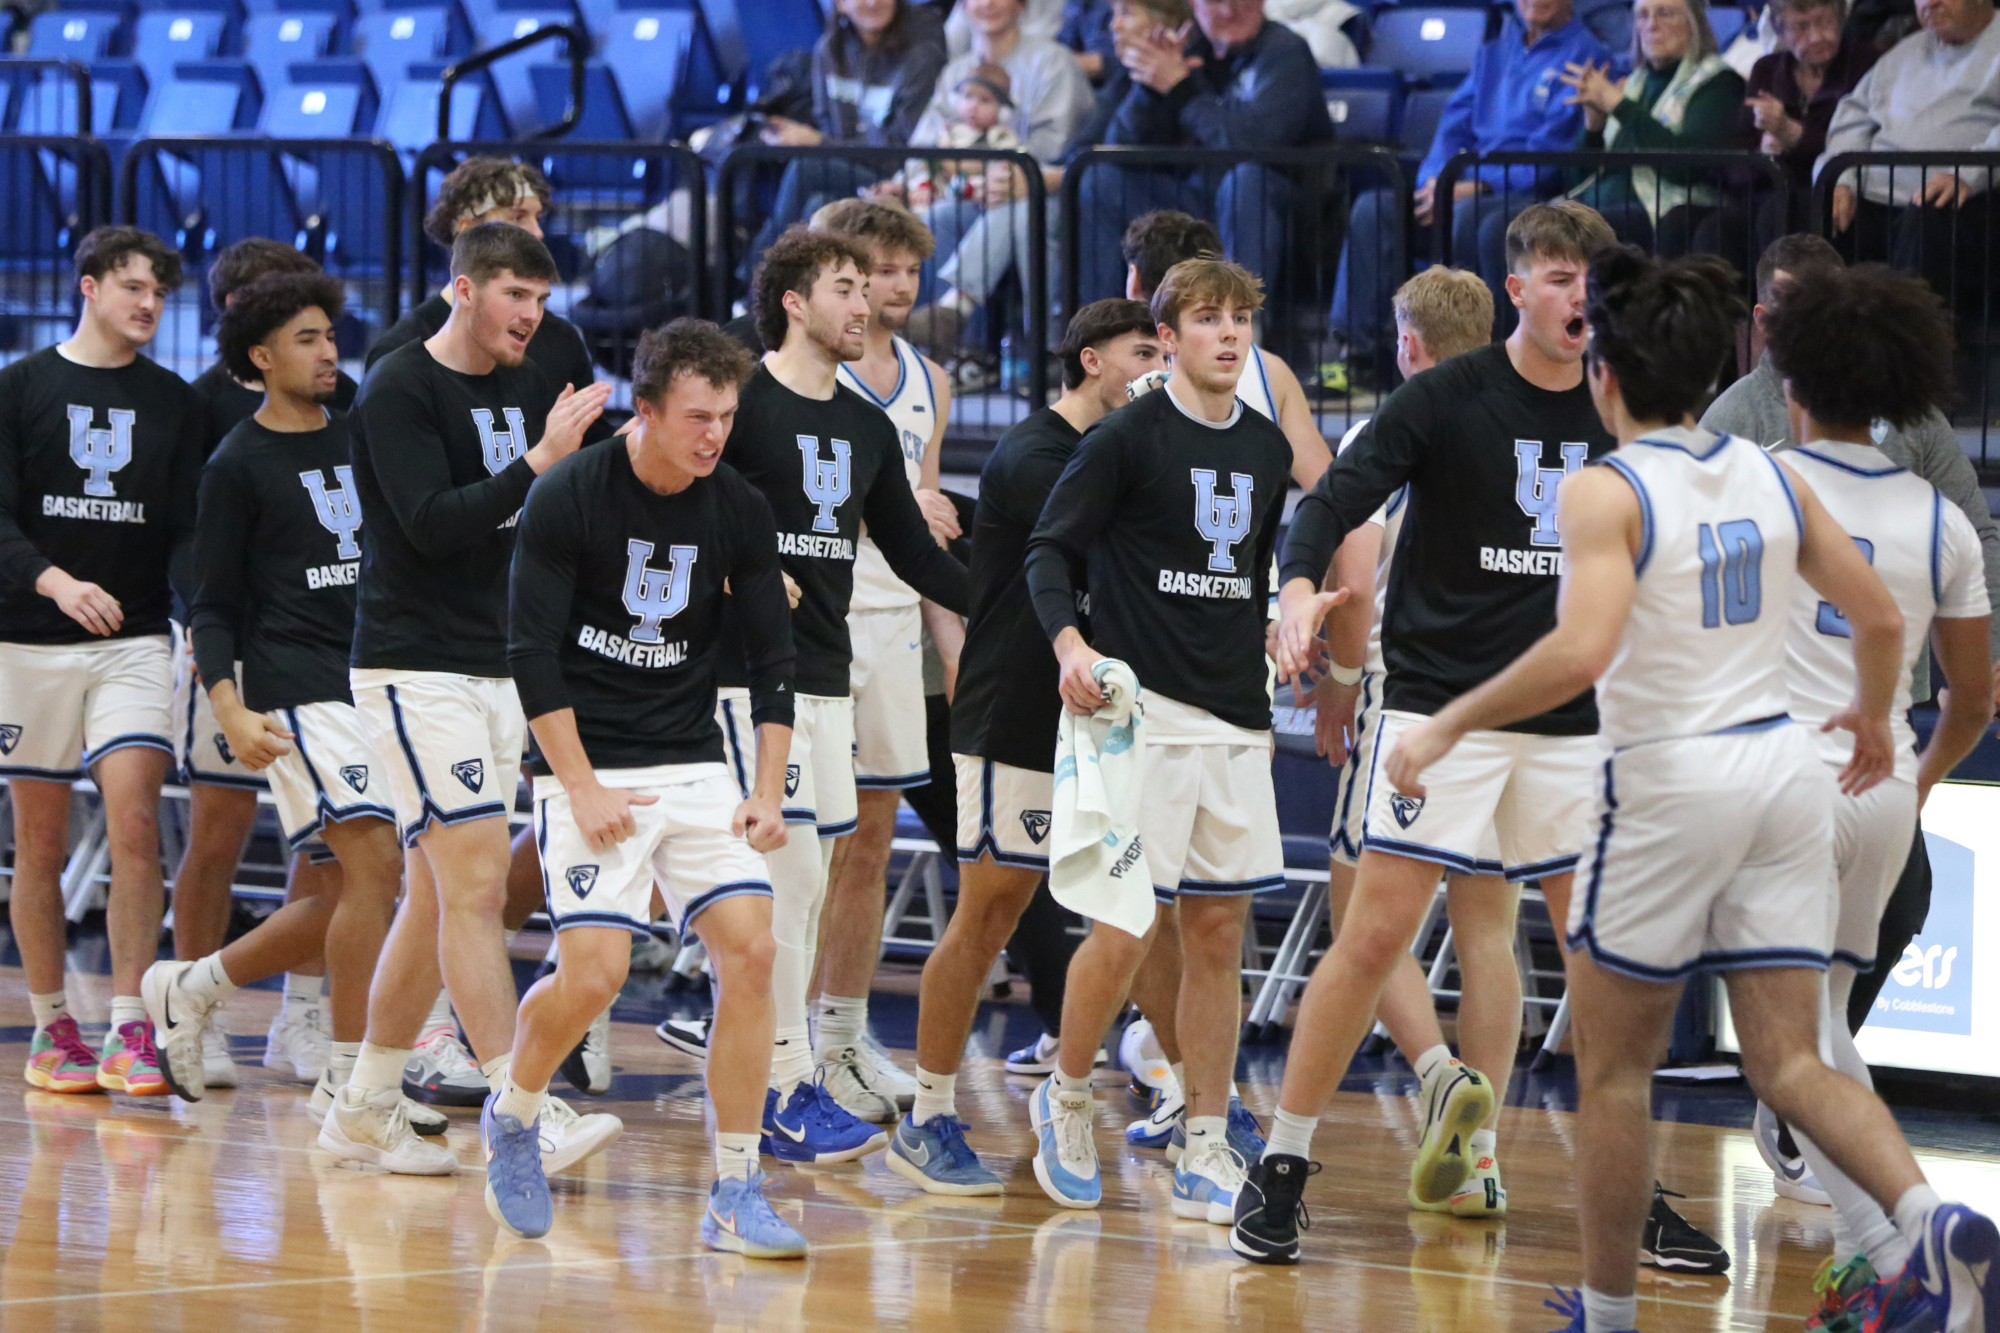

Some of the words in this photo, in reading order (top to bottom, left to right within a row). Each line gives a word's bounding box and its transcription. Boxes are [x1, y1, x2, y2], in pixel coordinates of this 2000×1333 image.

[43, 495, 146, 523] BASKETBALL
[1697, 518, 1764, 629] 10
[578, 625, 688, 668] BASKETBALL
[1892, 998, 1955, 1015] Cobblestone
